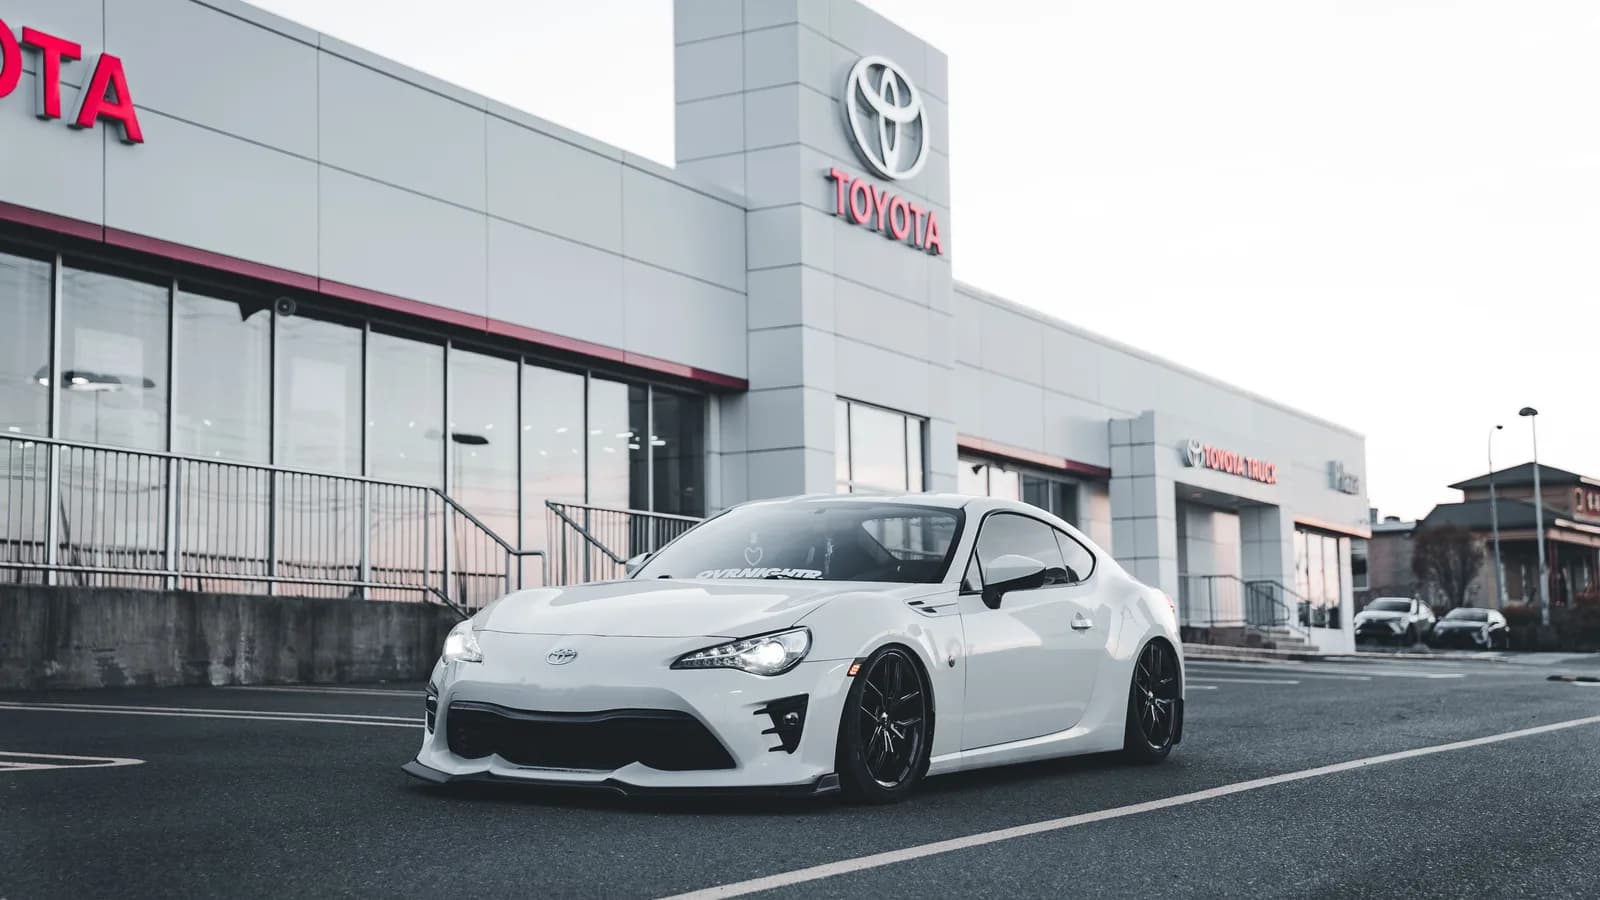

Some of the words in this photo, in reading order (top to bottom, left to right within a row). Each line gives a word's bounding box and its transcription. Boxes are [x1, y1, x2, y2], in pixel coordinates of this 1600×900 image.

[829, 167, 943, 255] TOYOTA
[1203, 446, 1244, 475] TOYOTA
[1245, 456, 1277, 484] TRUCK
